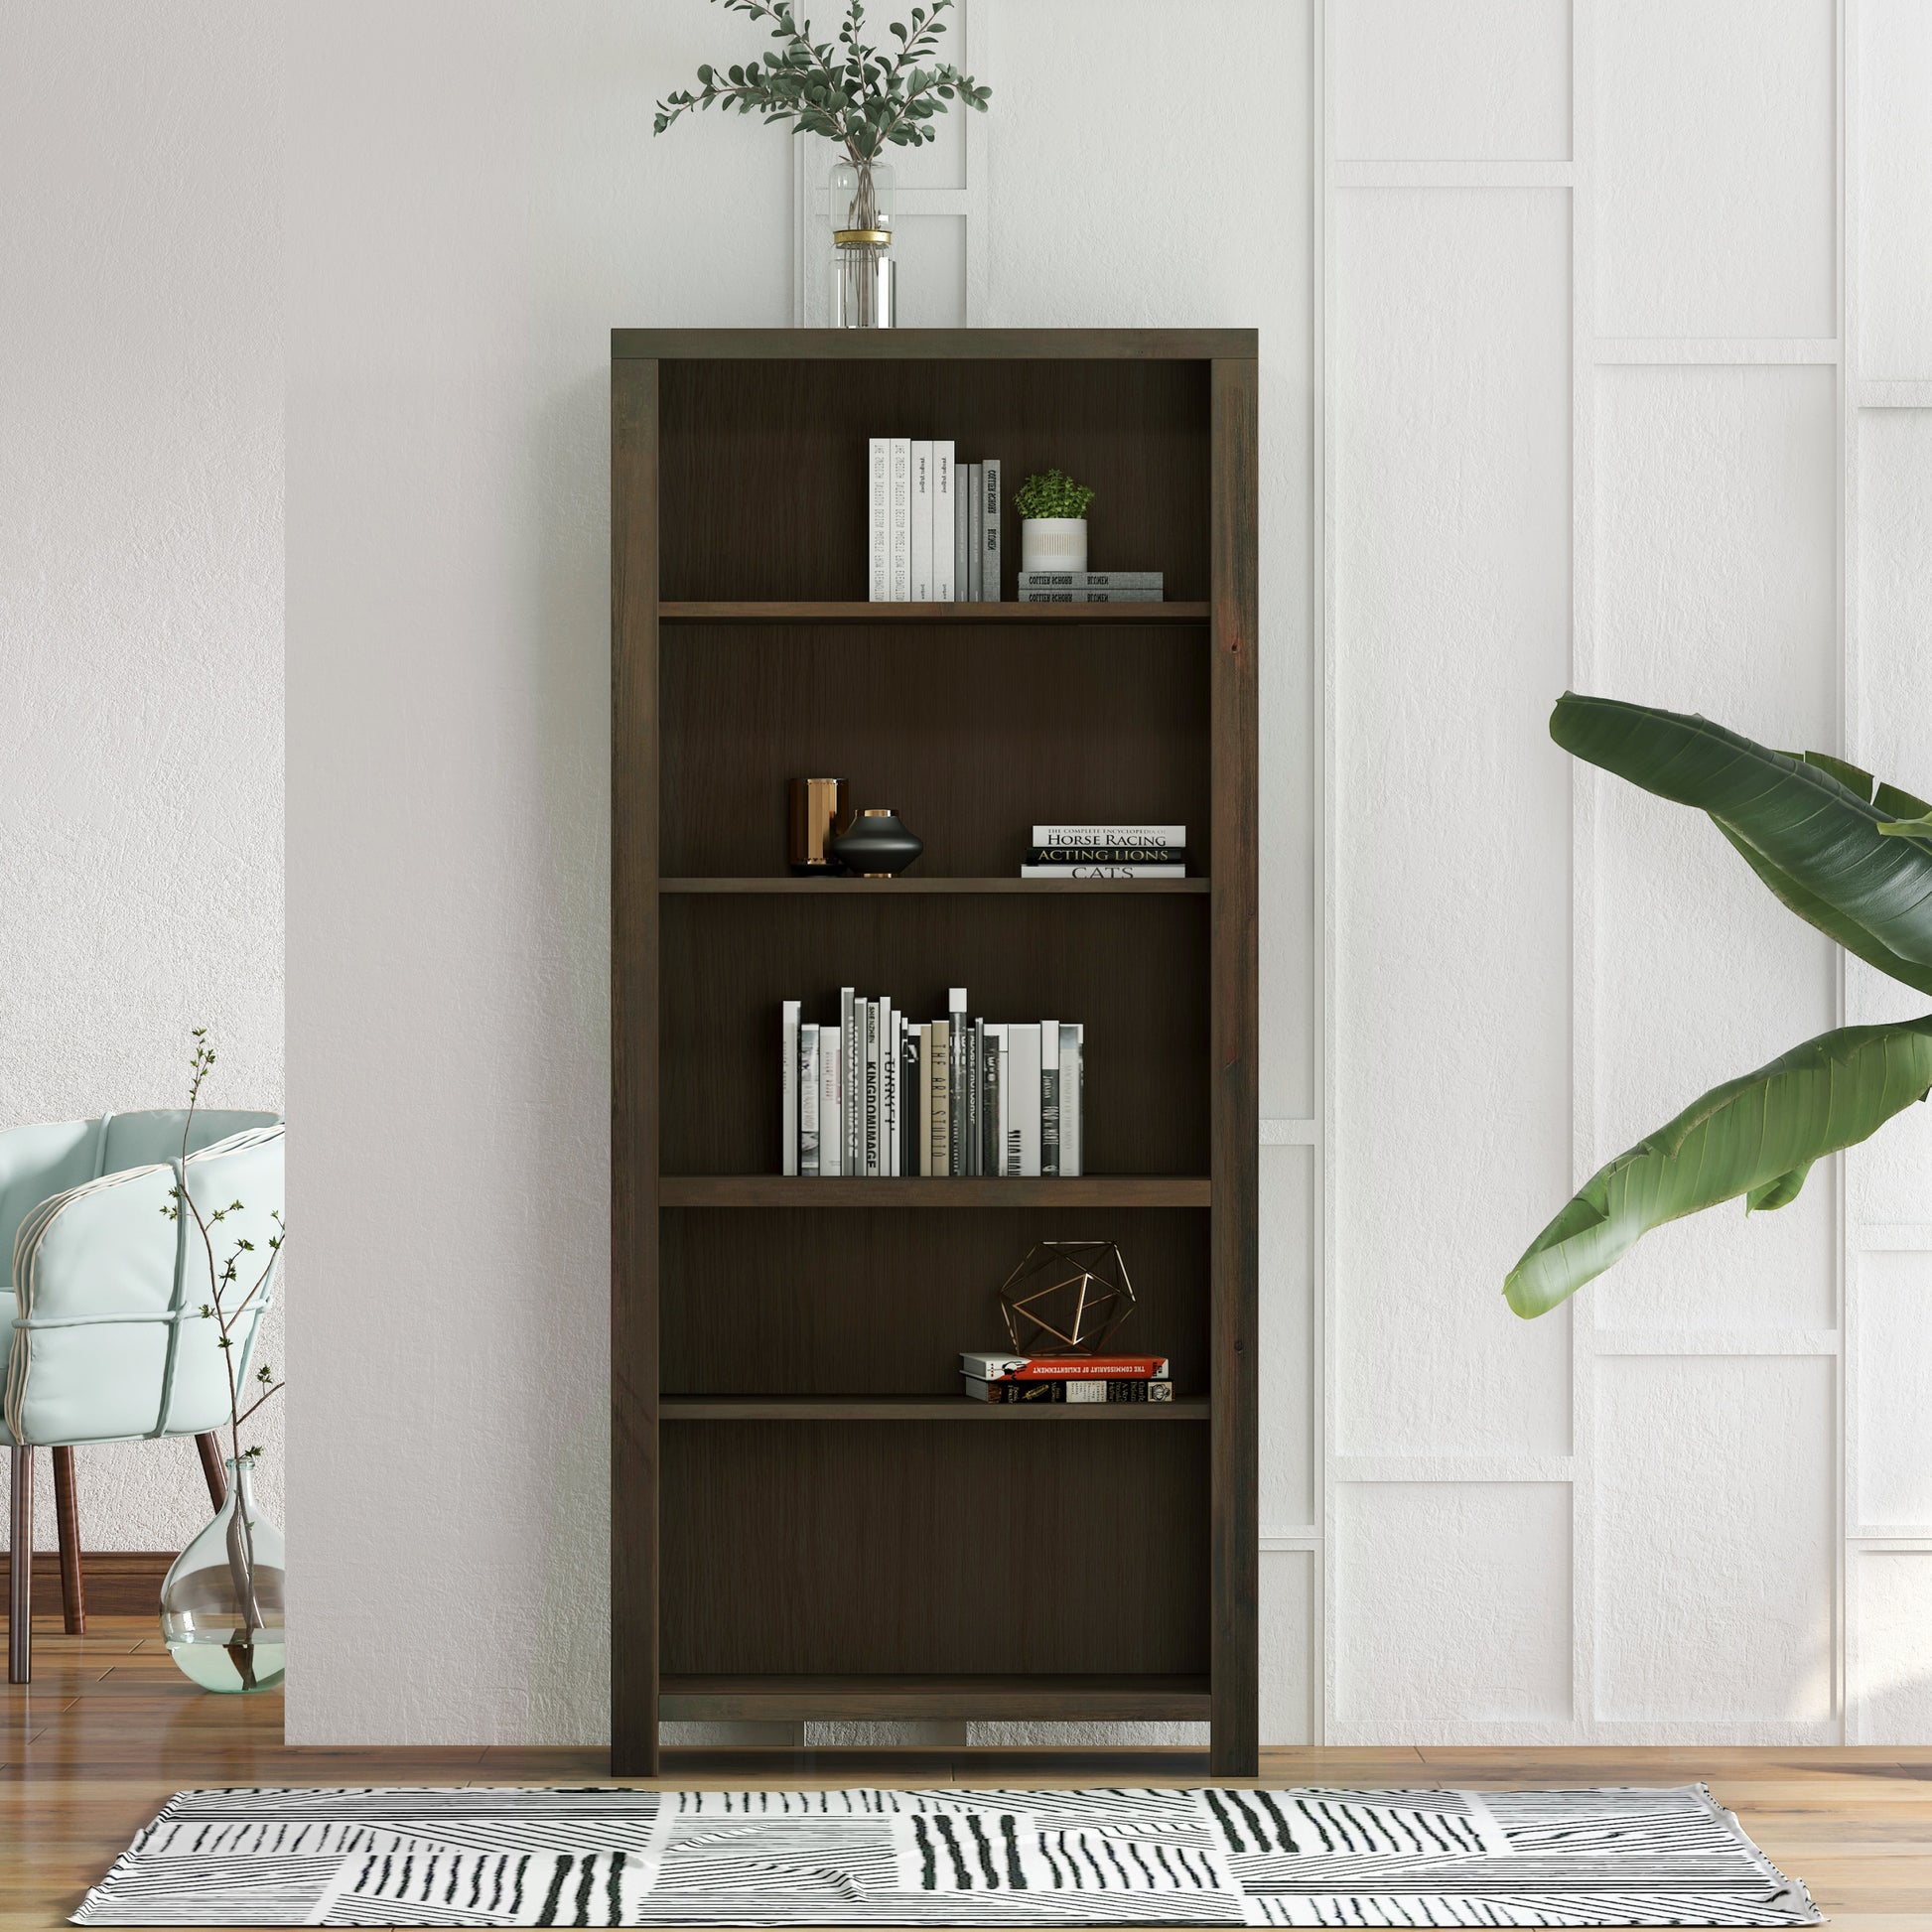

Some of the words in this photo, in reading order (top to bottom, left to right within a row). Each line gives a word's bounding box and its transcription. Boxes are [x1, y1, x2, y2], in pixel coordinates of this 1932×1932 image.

[1047, 835, 1100, 845] HORSE
[1106, 835, 1167, 846] RACING
[1038, 850, 1108, 861] ACTING
[1115, 850, 1169, 861] LIONS
[1072, 867, 1134, 878] CATS
[932, 1044, 945, 1065] THE
[932, 1077, 945, 1099] ART
[867, 1061, 877, 1169] KINGDOMIMAGE
[932, 1110, 945, 1158] STUDIO
